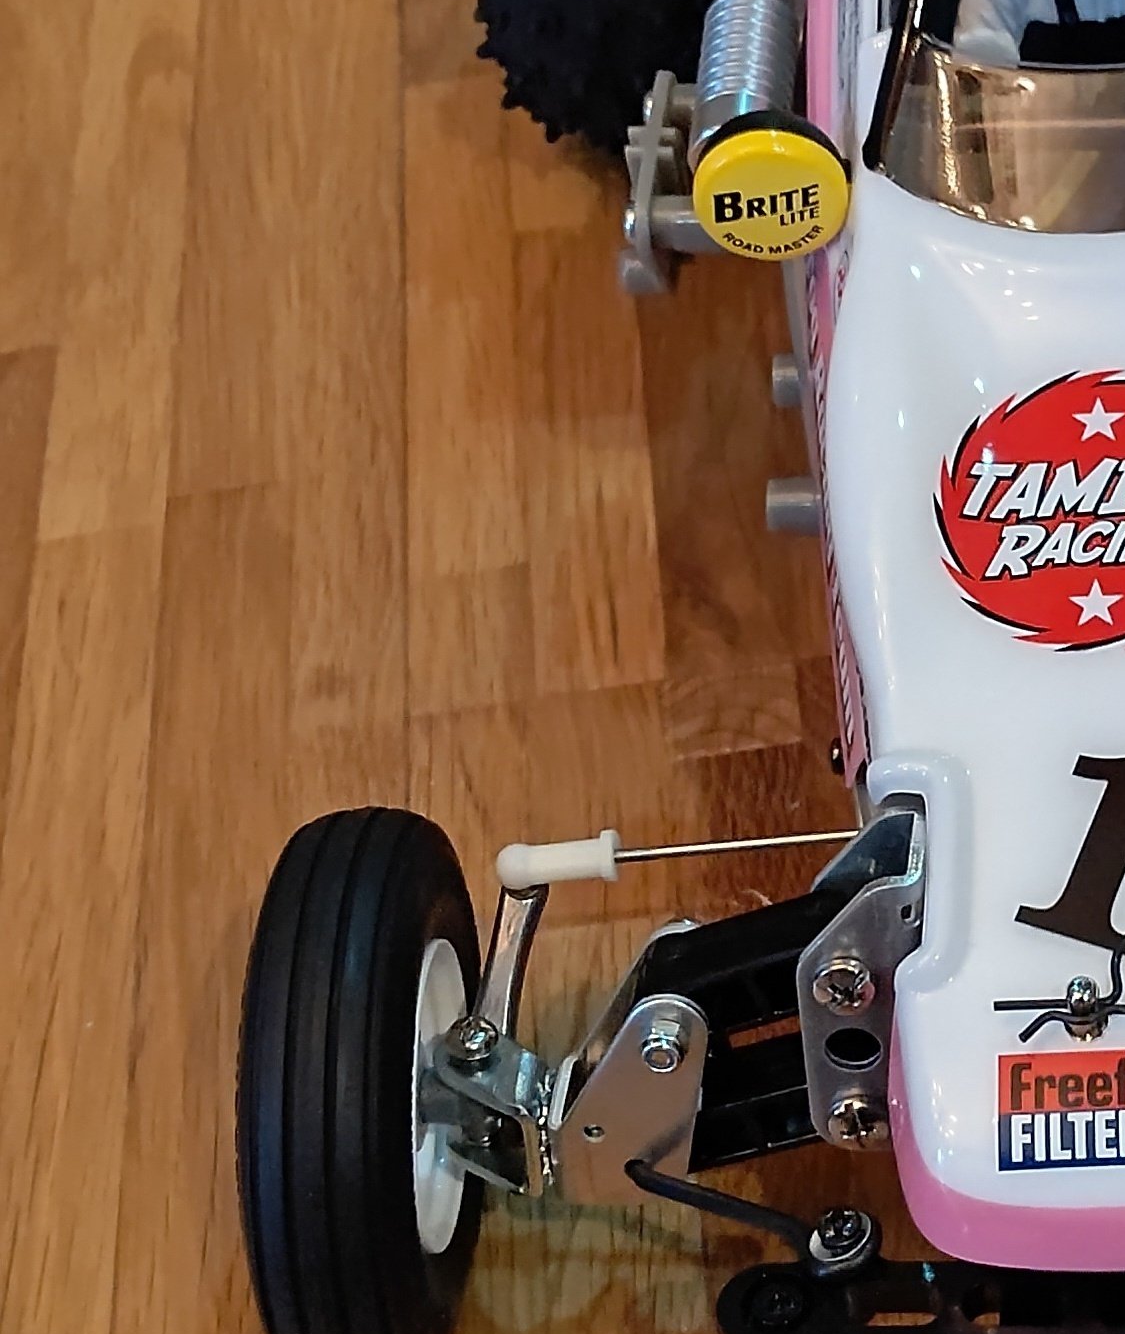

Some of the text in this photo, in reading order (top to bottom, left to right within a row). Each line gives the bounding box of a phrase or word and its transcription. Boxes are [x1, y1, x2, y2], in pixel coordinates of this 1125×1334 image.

[712, 183, 820, 224] BRITE
[779, 207, 821, 227] LITE
[722, 224, 825, 255] ROAD MASTER
